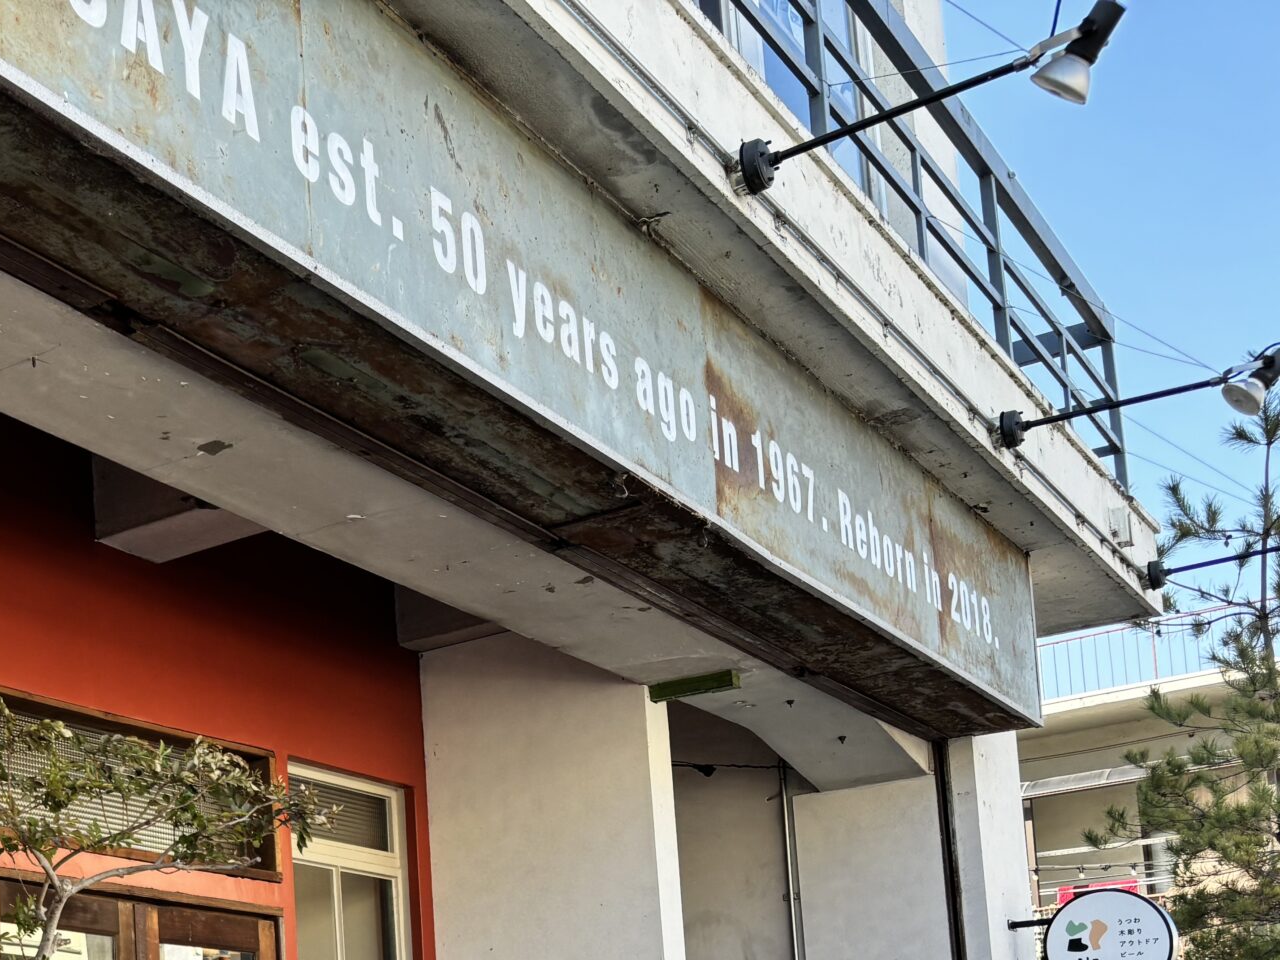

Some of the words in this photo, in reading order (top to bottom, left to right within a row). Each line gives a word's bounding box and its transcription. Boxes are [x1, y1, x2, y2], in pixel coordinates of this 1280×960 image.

[70, 0, 260, 143] AYA
[290, 105, 404, 242] est.
[430, 186, 487, 295] 50
[506, 259, 619, 390] years
[634, 356, 697, 442] ago
[710, 394, 740, 473] in
[837, 488, 917, 593] Reborn
[923, 551, 943, 612] in
[948, 572, 1000, 650] 2018.
[1117, 918, 1141, 926] うつわ
[1118, 928, 1142, 936] 木彫り
[1119, 937, 1160, 948] アウトドア
